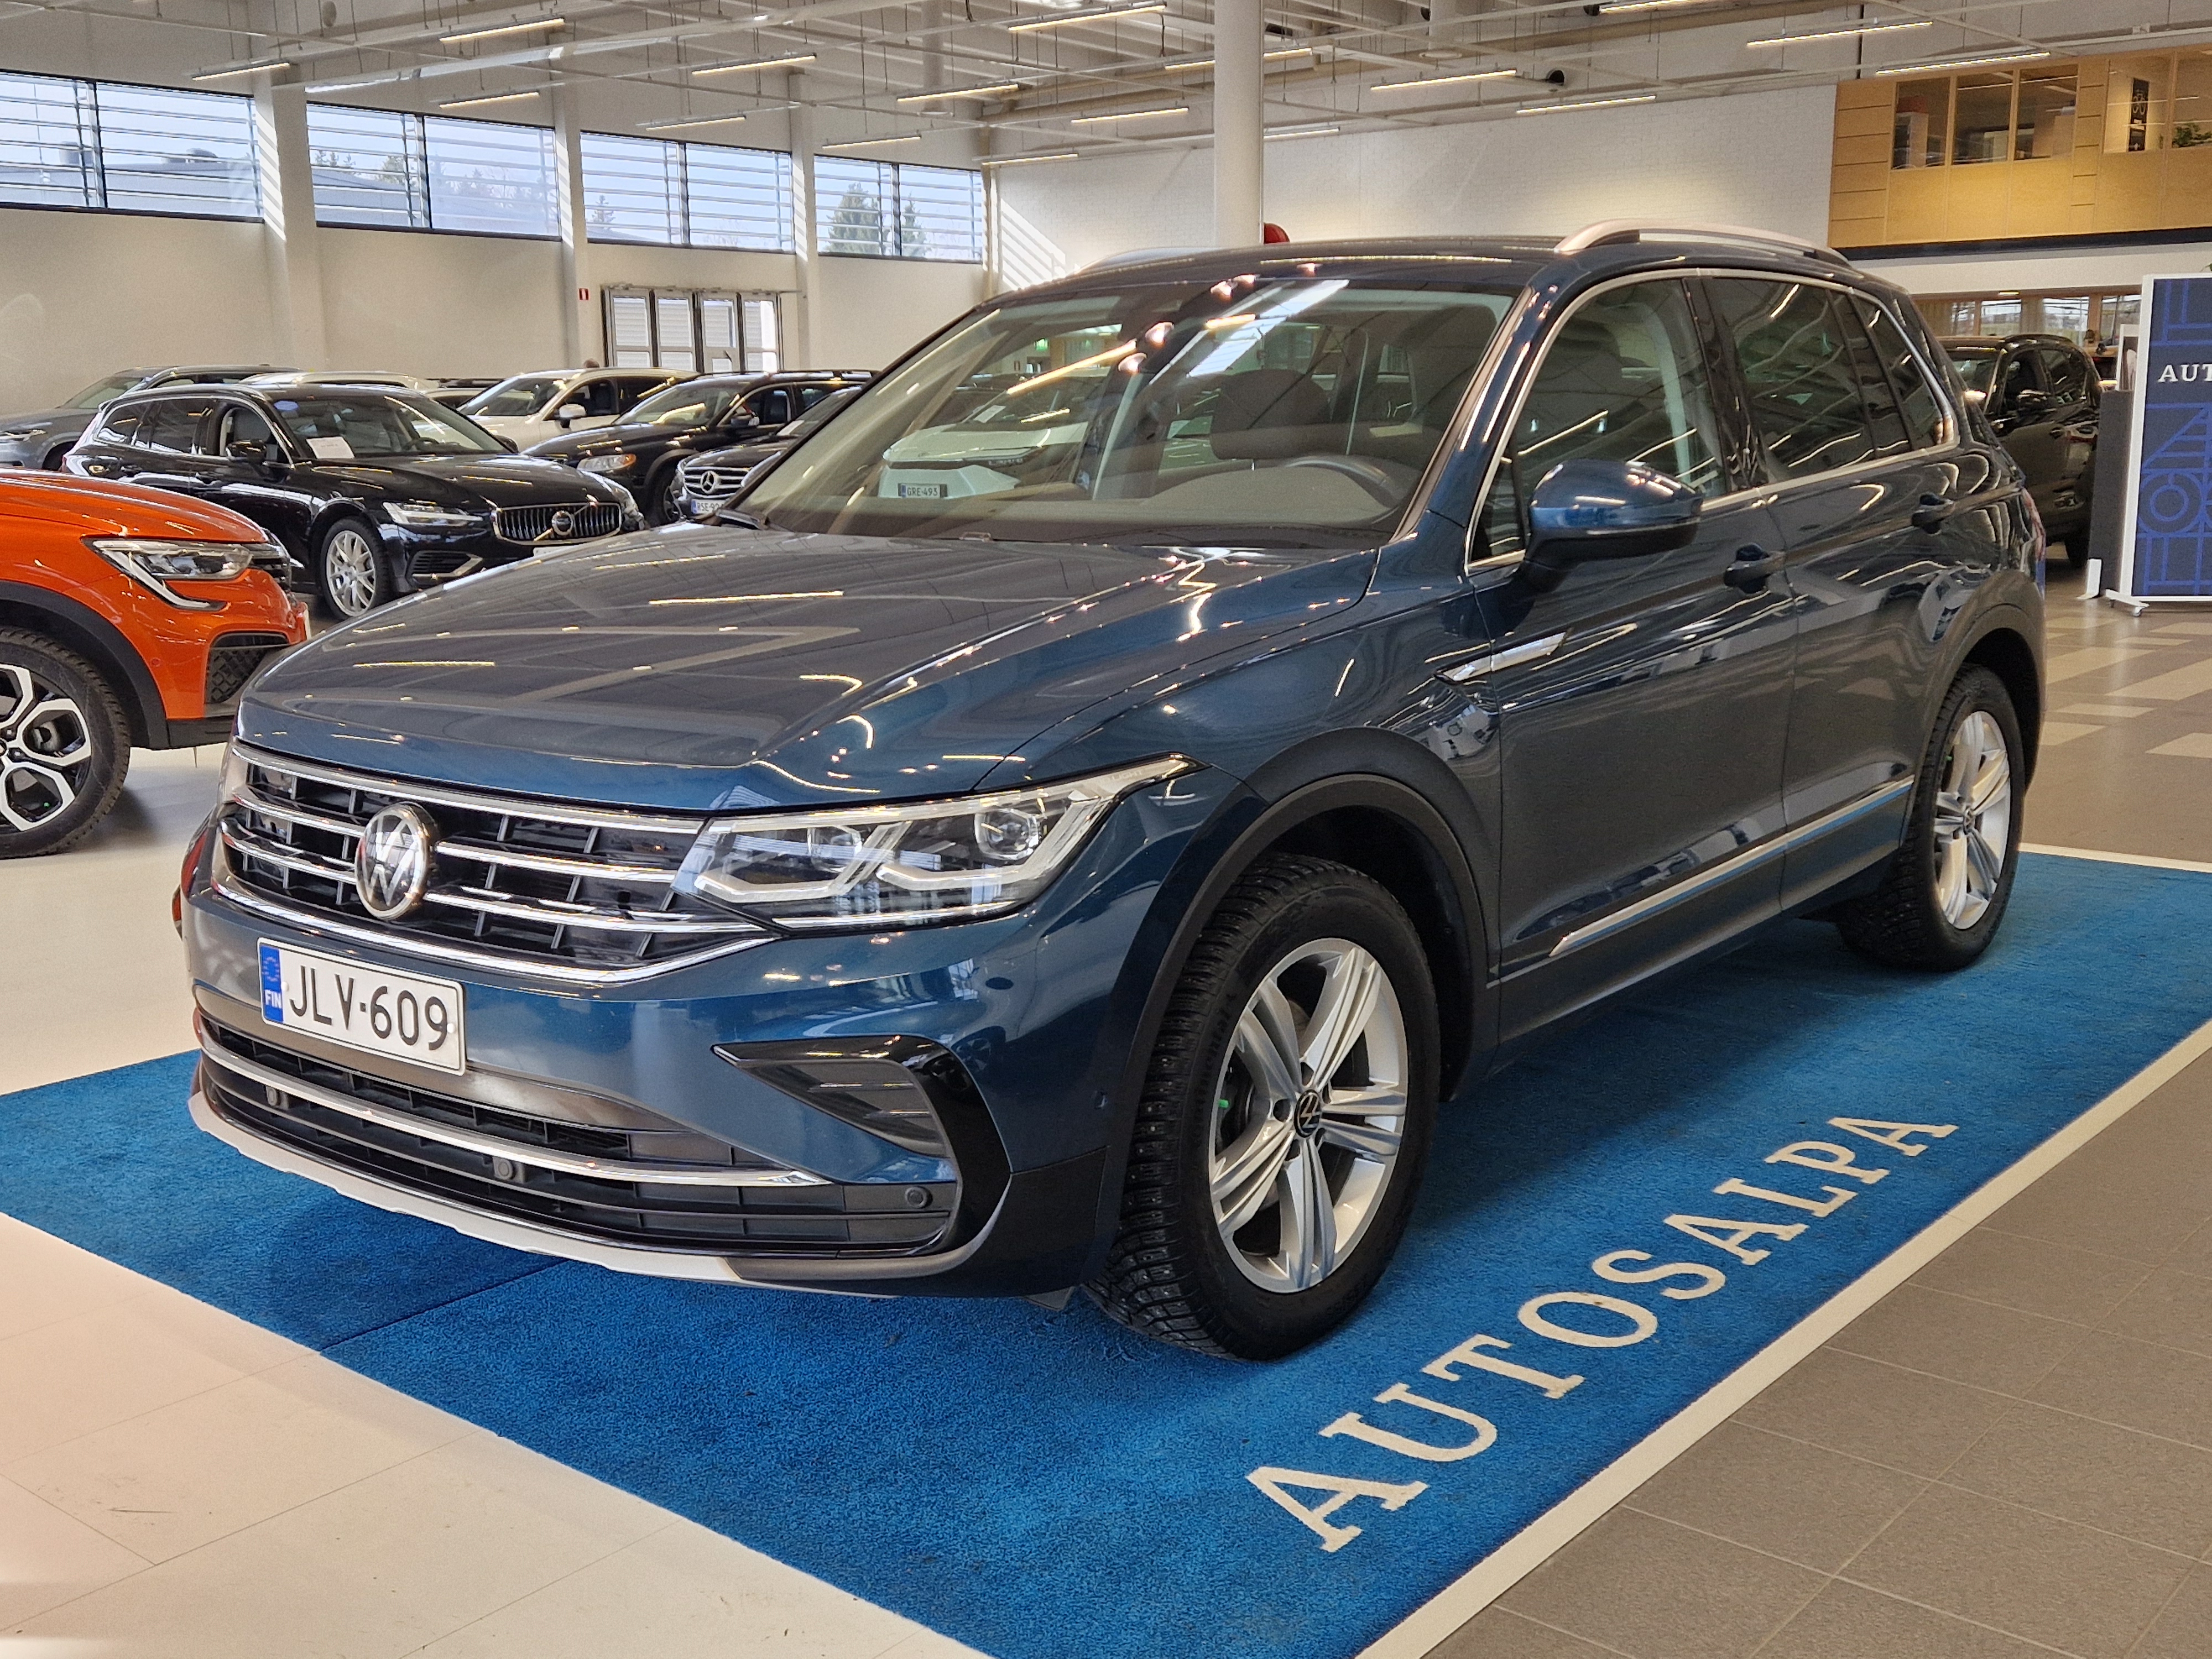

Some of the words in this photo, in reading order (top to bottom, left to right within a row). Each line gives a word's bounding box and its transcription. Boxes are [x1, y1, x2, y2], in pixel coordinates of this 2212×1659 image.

[907, 487, 938, 497] GRE-493
[265, 989, 282, 1009] FIN
[289, 964, 447, 1051] JLV-609
[1246, 1116, 1959, 1553] AUTOSALPA
